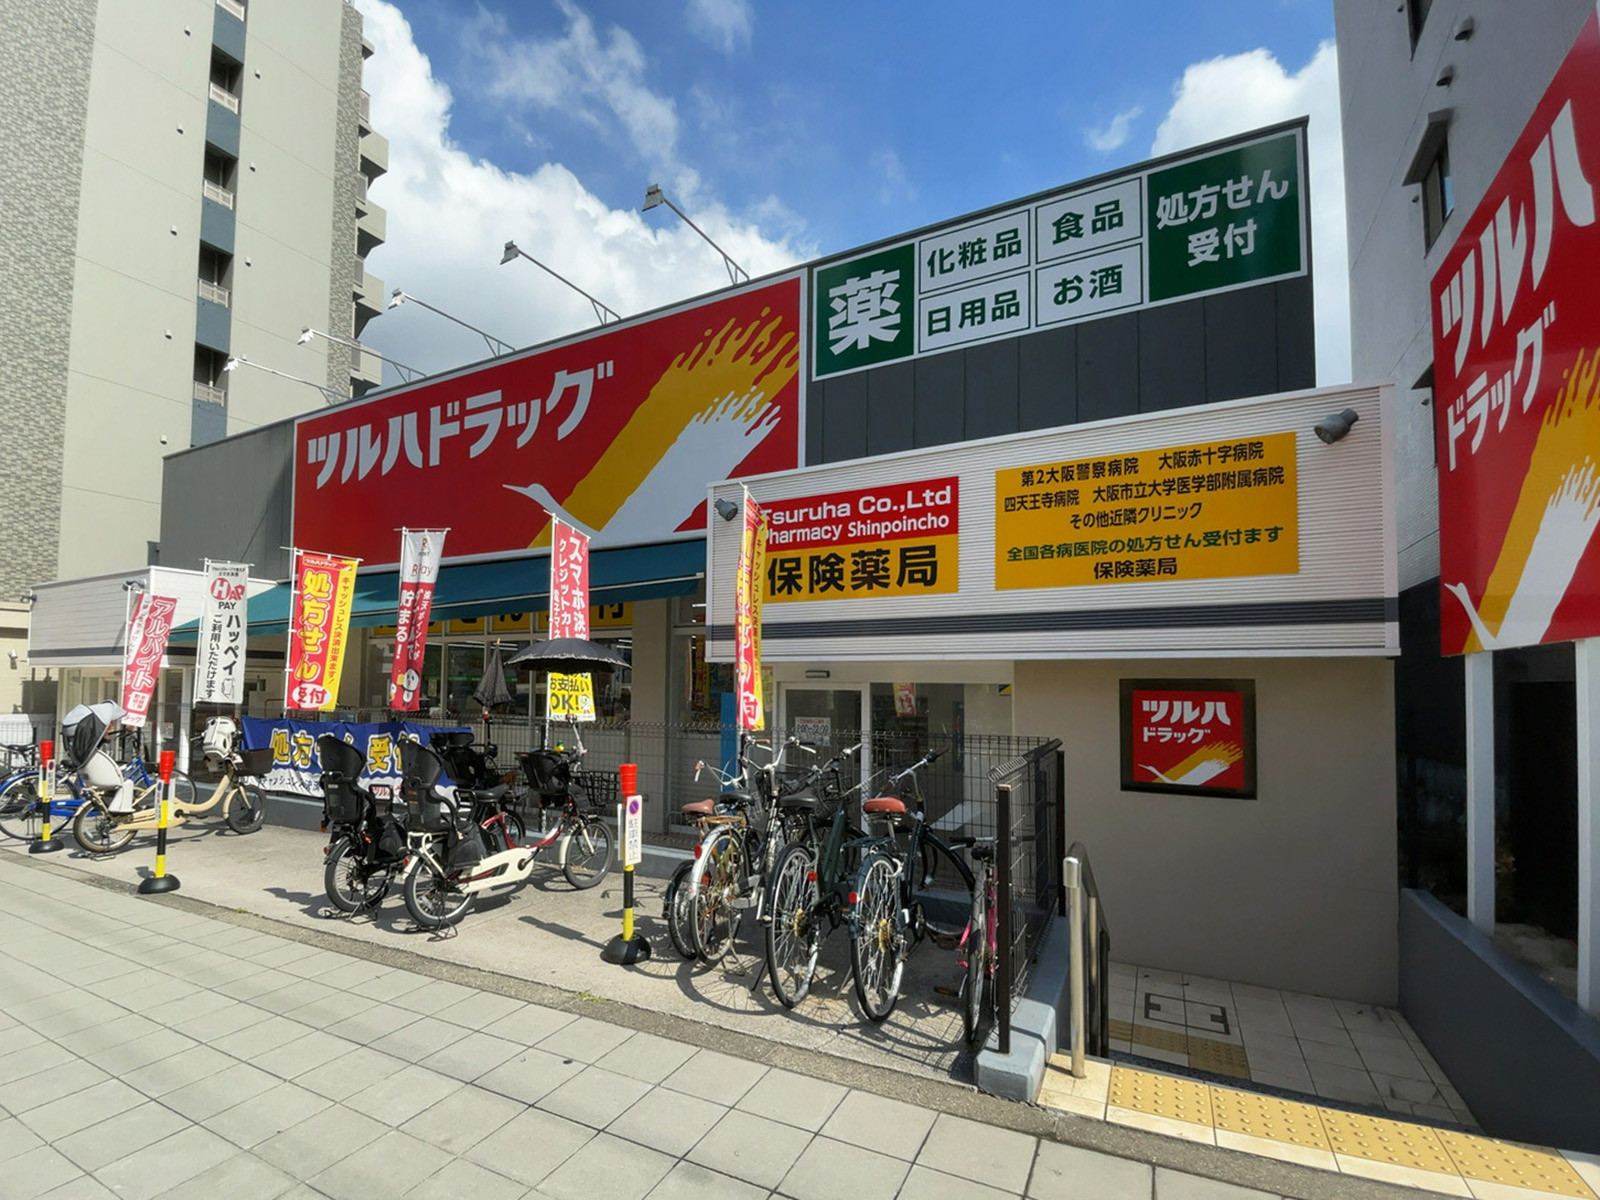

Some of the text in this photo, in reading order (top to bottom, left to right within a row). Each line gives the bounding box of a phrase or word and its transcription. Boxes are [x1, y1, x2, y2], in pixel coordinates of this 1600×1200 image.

[1051, 199, 1125, 246] 食品
[1155, 168, 1289, 231] 処方せん
[926, 226, 1023, 278] 化粧品
[1187, 218, 1258, 267] 受付
[1439, 98, 1596, 378] ツルハ
[1052, 263, 1124, 306] お酒
[827, 268, 901, 357] 薬
[926, 288, 1021, 338] 日用品
[1447, 300, 1556, 473] ドラッグ
[307, 359, 615, 490] ツルハドラッグ
[1021, 440, 1264, 487] 第2大阪警察病院 大阪赤十字病院
[1004, 466, 1285, 512] 四天王寺病院 大阪市立大学医学部附属病院
[847, 512, 950, 539] Shinpoincho
[1069, 502, 1203, 530] その他近隣クリニック
[1006, 526, 1284, 562] 全国各病医院の処方せん受付ます
[1093, 557, 1178, 580] 保険薬局
[768, 545, 939, 597] 保険薬局
[218, 601, 237, 610] PAY
[294, 569, 334, 681] 処方せん
[132, 600, 174, 691] アルバイト
[206, 614, 223, 699] ご利用いただけます
[222, 614, 242, 676] ハッペイ
[297, 685, 328, 705] 受付
[1141, 699, 1231, 726] ツルハ
[1142, 726, 1211, 745] ドラッグ
